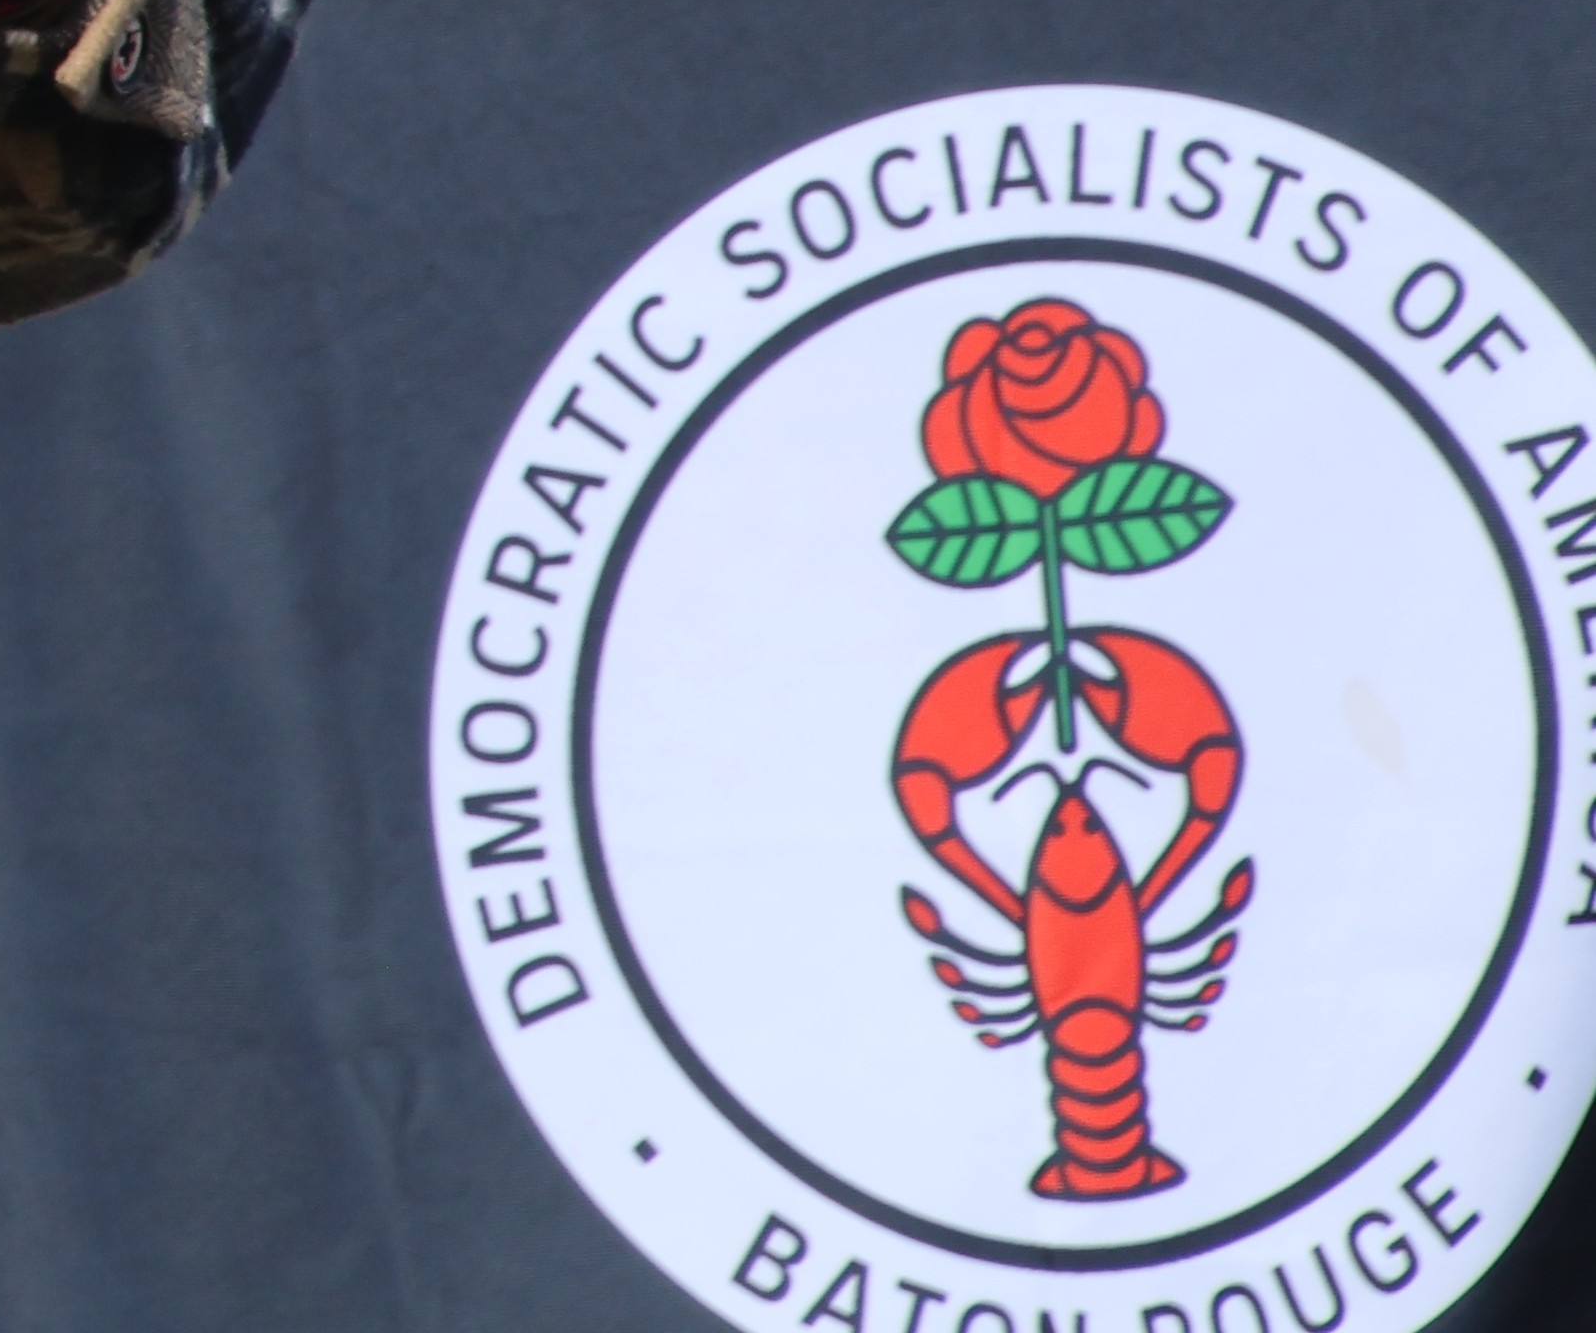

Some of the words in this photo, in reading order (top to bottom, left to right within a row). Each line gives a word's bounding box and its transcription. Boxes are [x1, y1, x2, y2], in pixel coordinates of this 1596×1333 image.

[461, 295, 703, 1029] DEMOCRATIC
[719, 123, 1366, 300] SOCIALISTS
[1392, 262, 1526, 380] OF
[732, 1214, 1086, 1333] BAT
